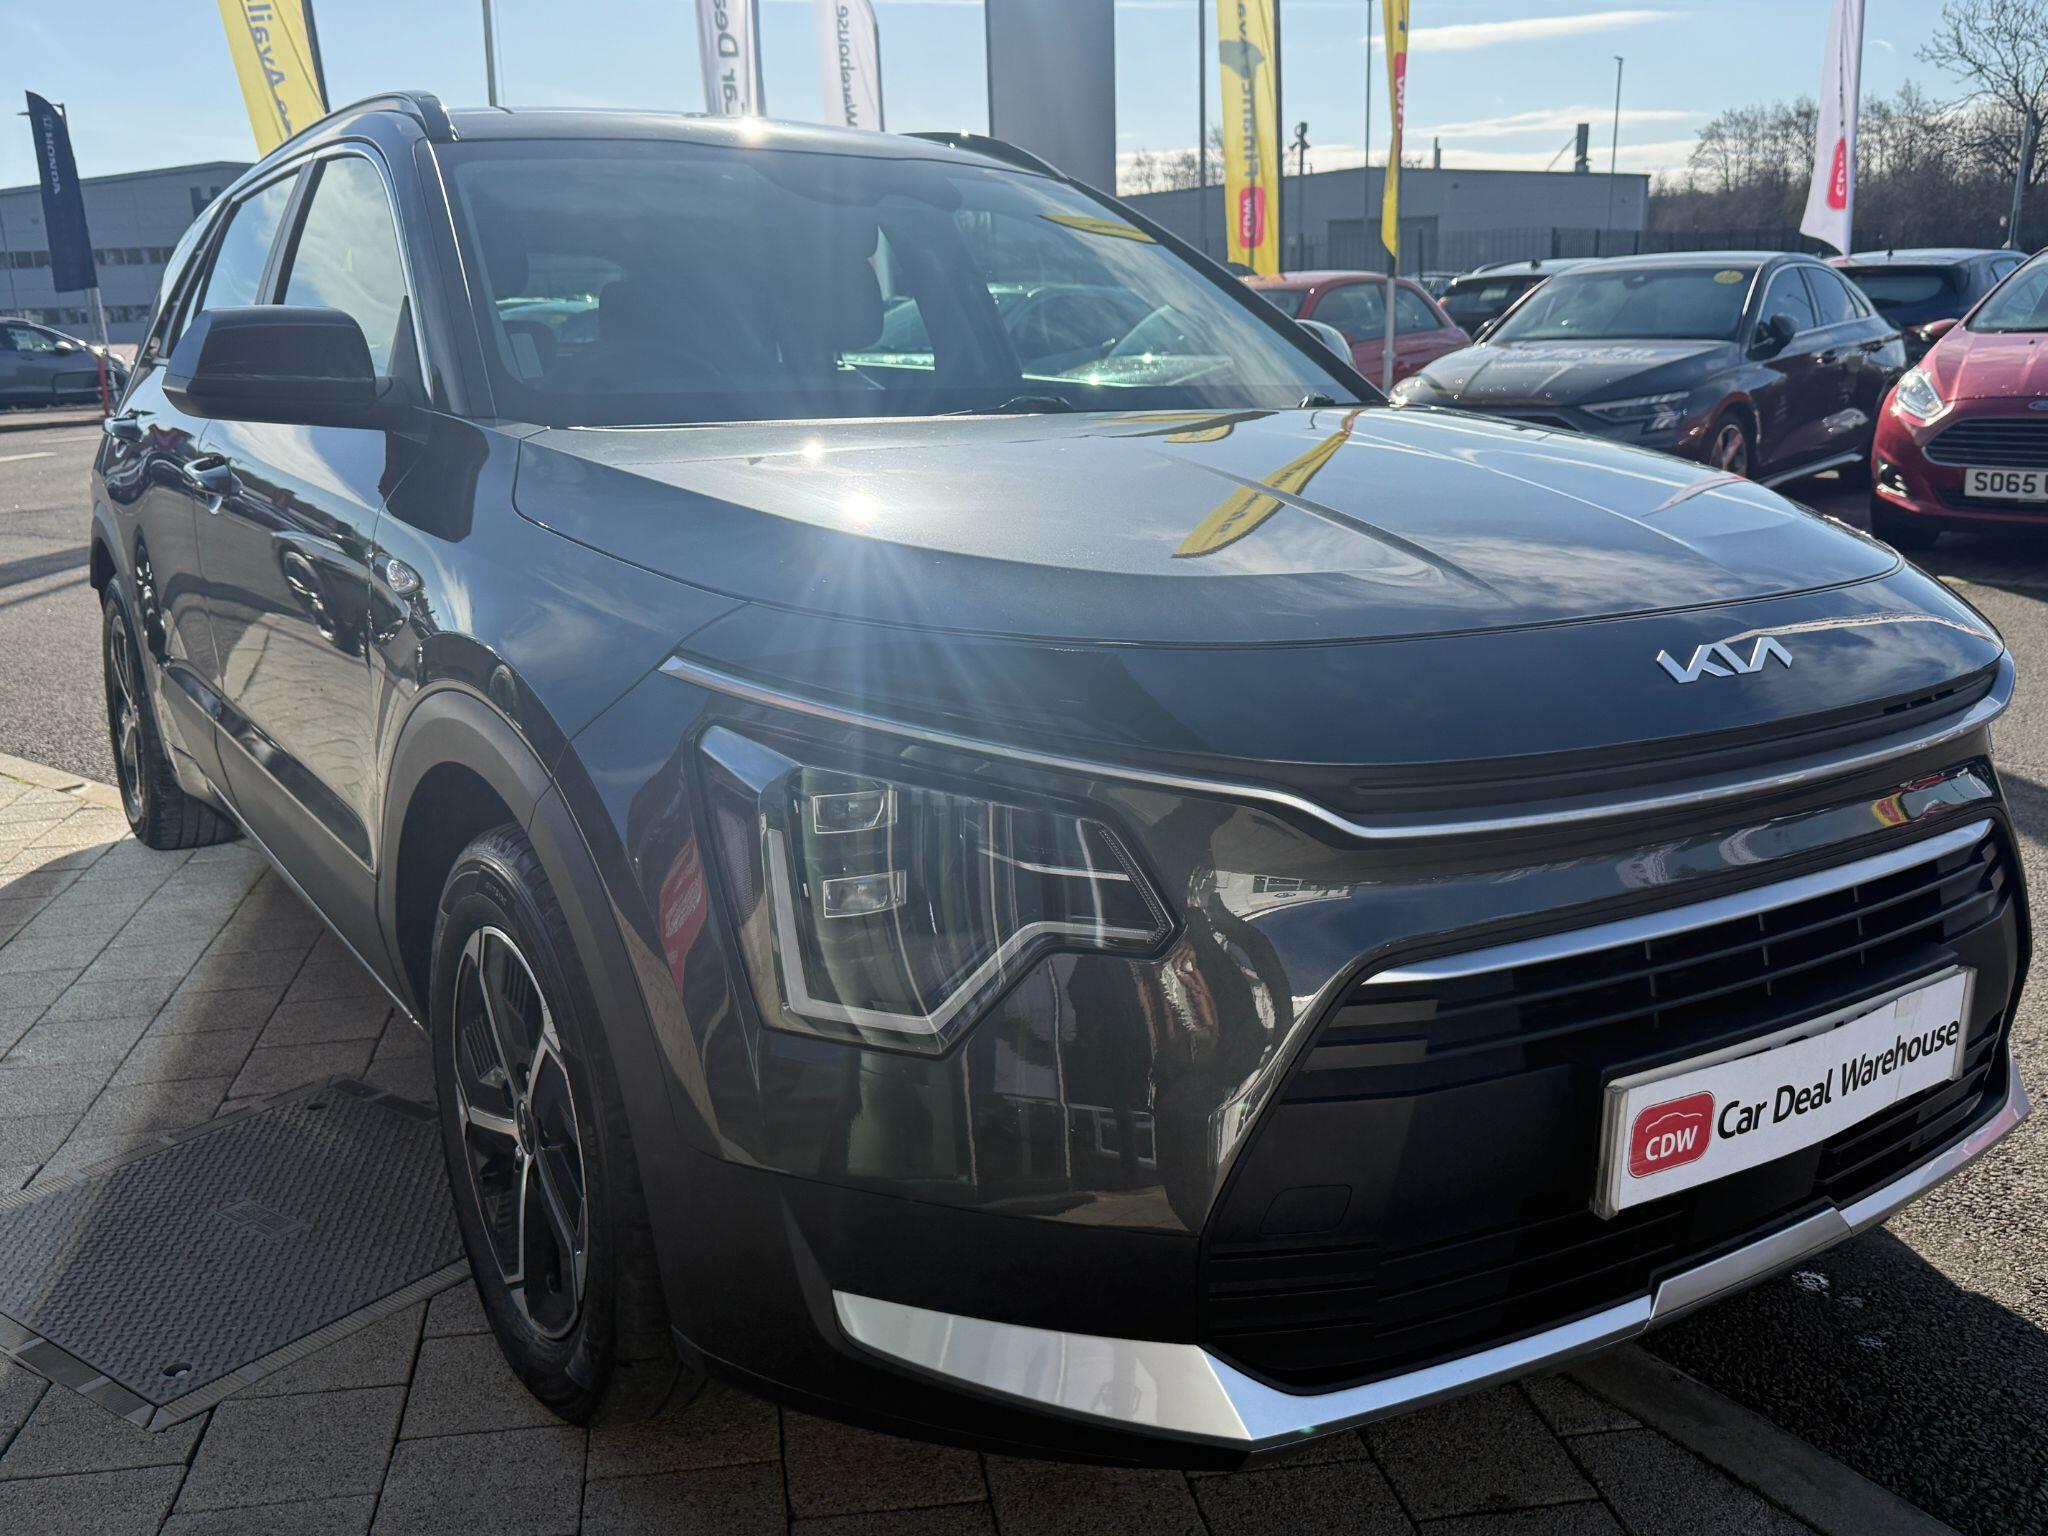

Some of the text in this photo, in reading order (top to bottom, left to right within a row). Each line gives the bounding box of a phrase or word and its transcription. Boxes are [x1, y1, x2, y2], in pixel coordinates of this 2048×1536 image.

[45, 132, 61, 195] HONDA
[1974, 471, 2037, 494] SO65
[1656, 637, 1793, 684] KIA
[1717, 1100, 1767, 1139] Car
[1773, 1069, 1832, 1124] Deal
[1841, 1020, 1960, 1096] Warehouse
[1645, 1126, 1698, 1161] CDW
